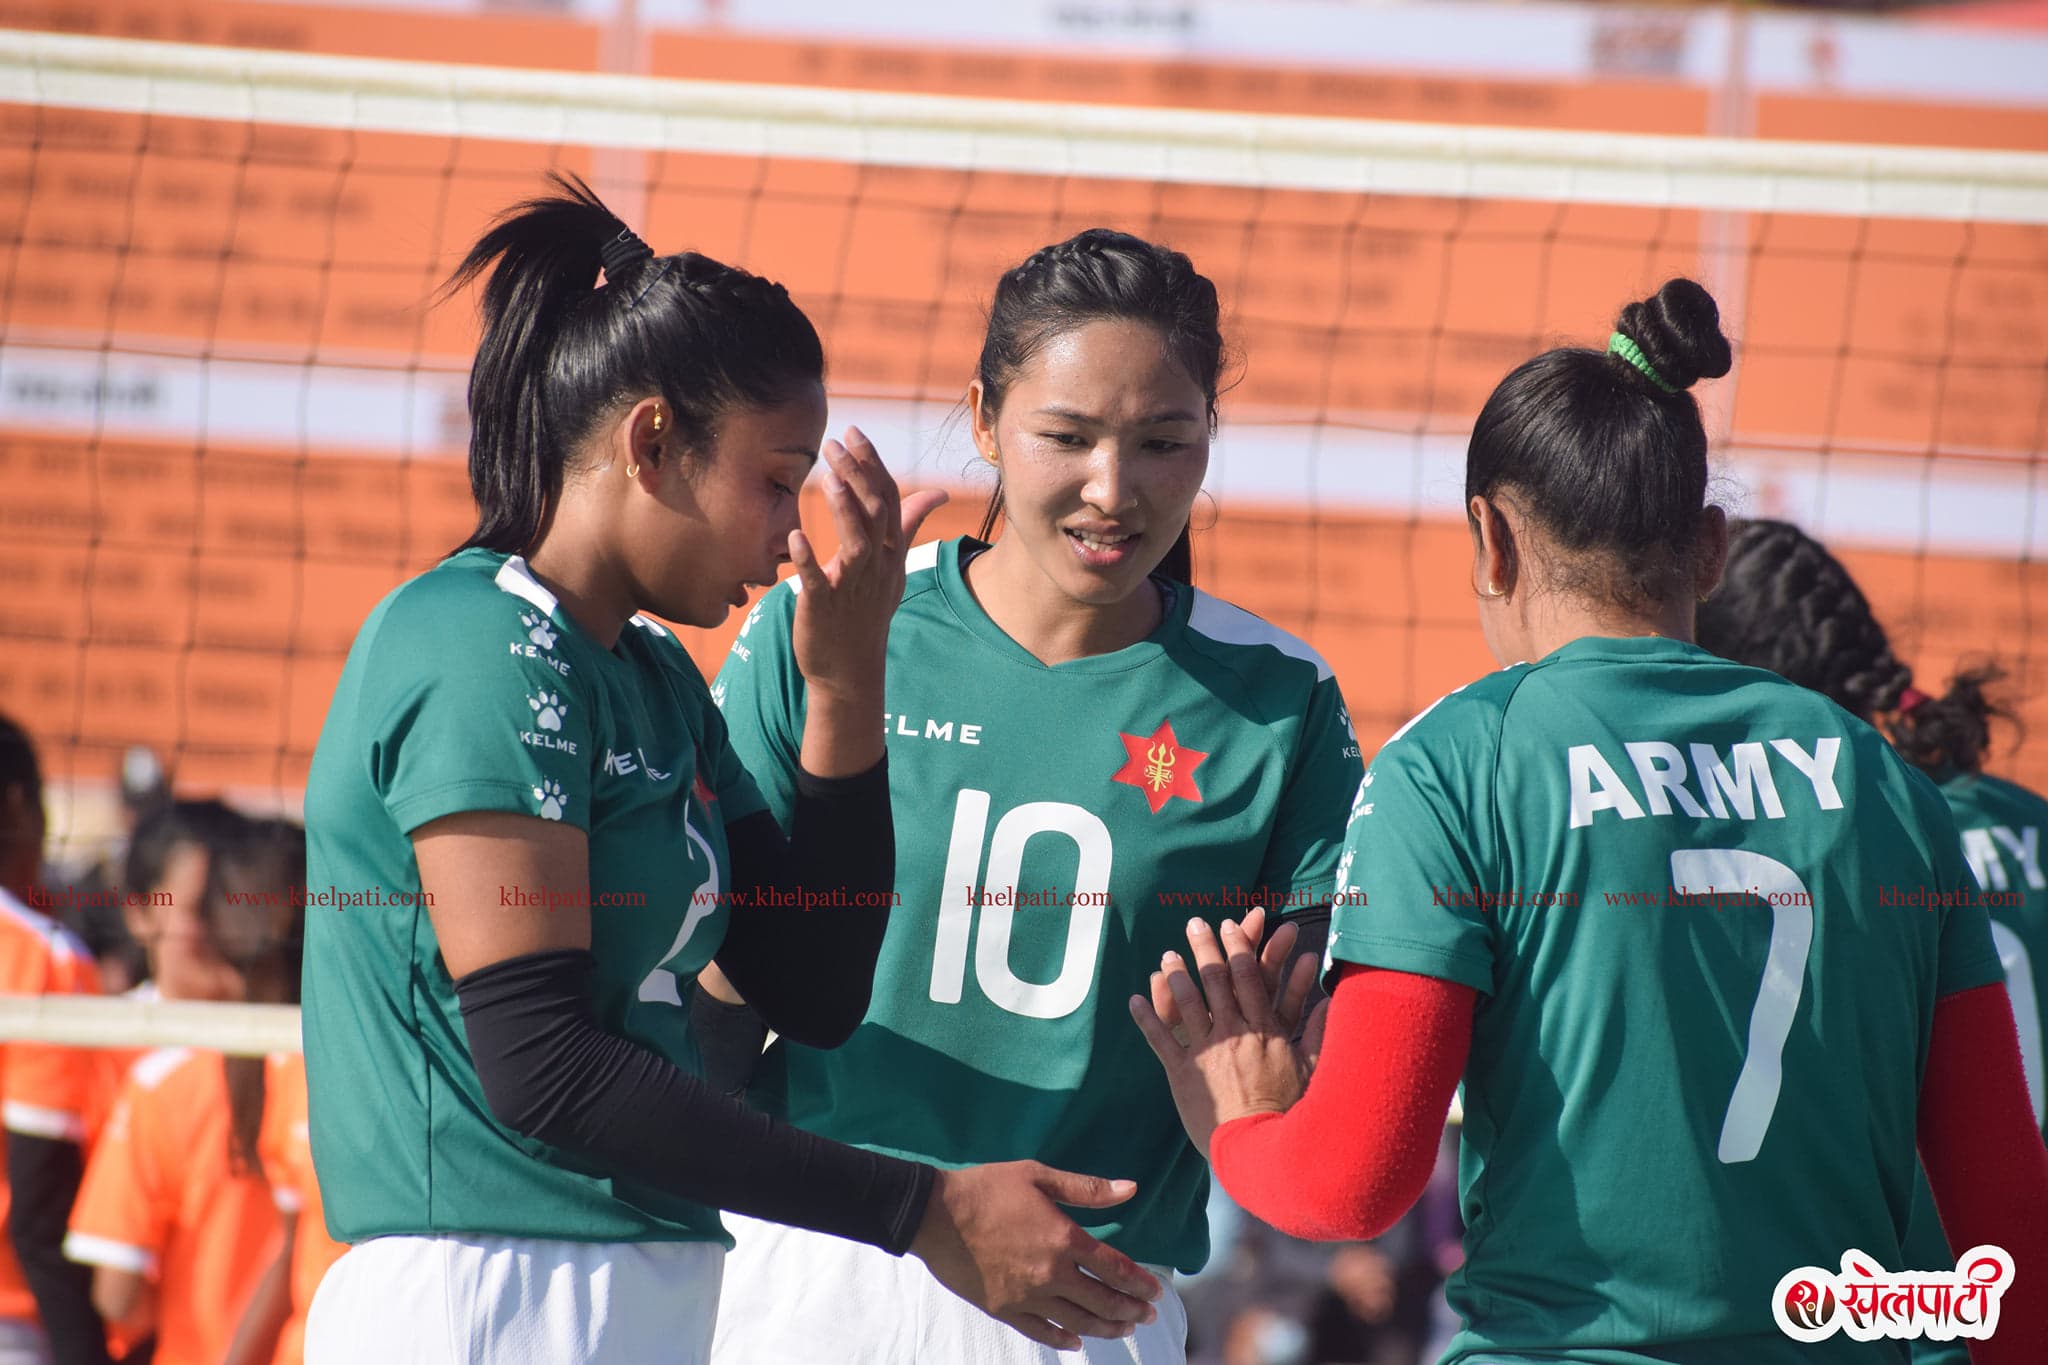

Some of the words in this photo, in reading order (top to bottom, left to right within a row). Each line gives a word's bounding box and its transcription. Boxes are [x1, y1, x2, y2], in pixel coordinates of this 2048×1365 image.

[519, 730, 577, 756] KELME
[1568, 736, 1845, 830] ARMY
[929, 788, 1114, 1020] 10
[1670, 848, 1814, 1164] 7
